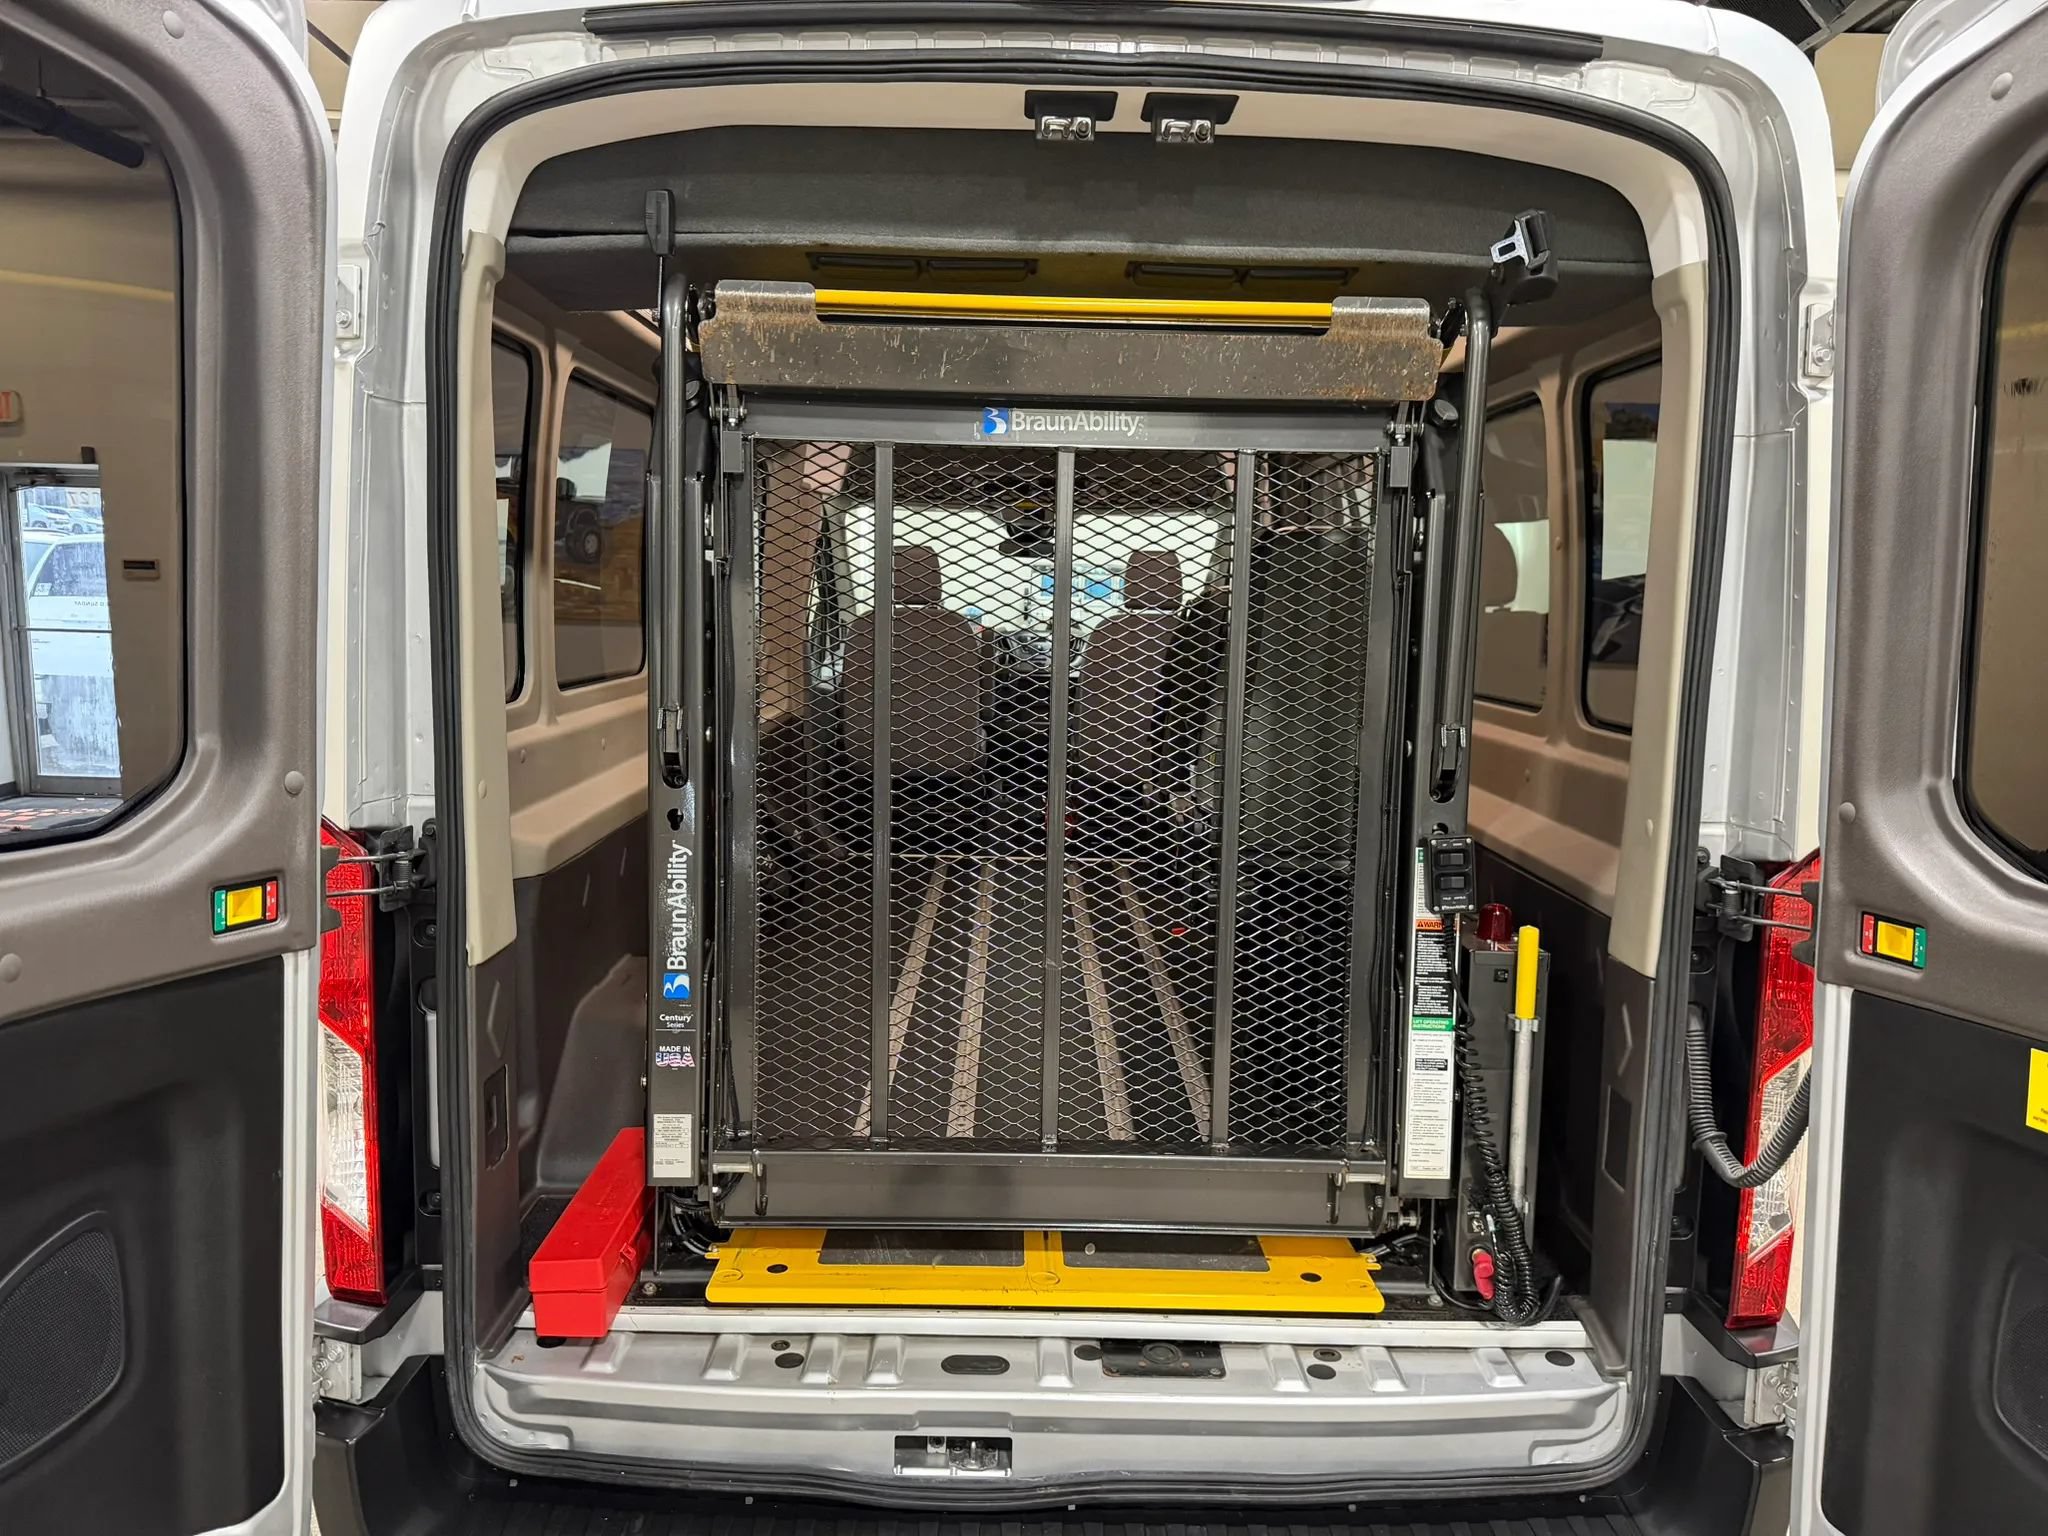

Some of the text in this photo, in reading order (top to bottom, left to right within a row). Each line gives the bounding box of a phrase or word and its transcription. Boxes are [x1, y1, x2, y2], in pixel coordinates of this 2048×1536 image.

[1011, 411, 1138, 437] BraunAbility
[666, 843, 693, 970] BraunAbility
[659, 1014, 692, 1023] Century
[656, 1053, 695, 1067] USA
